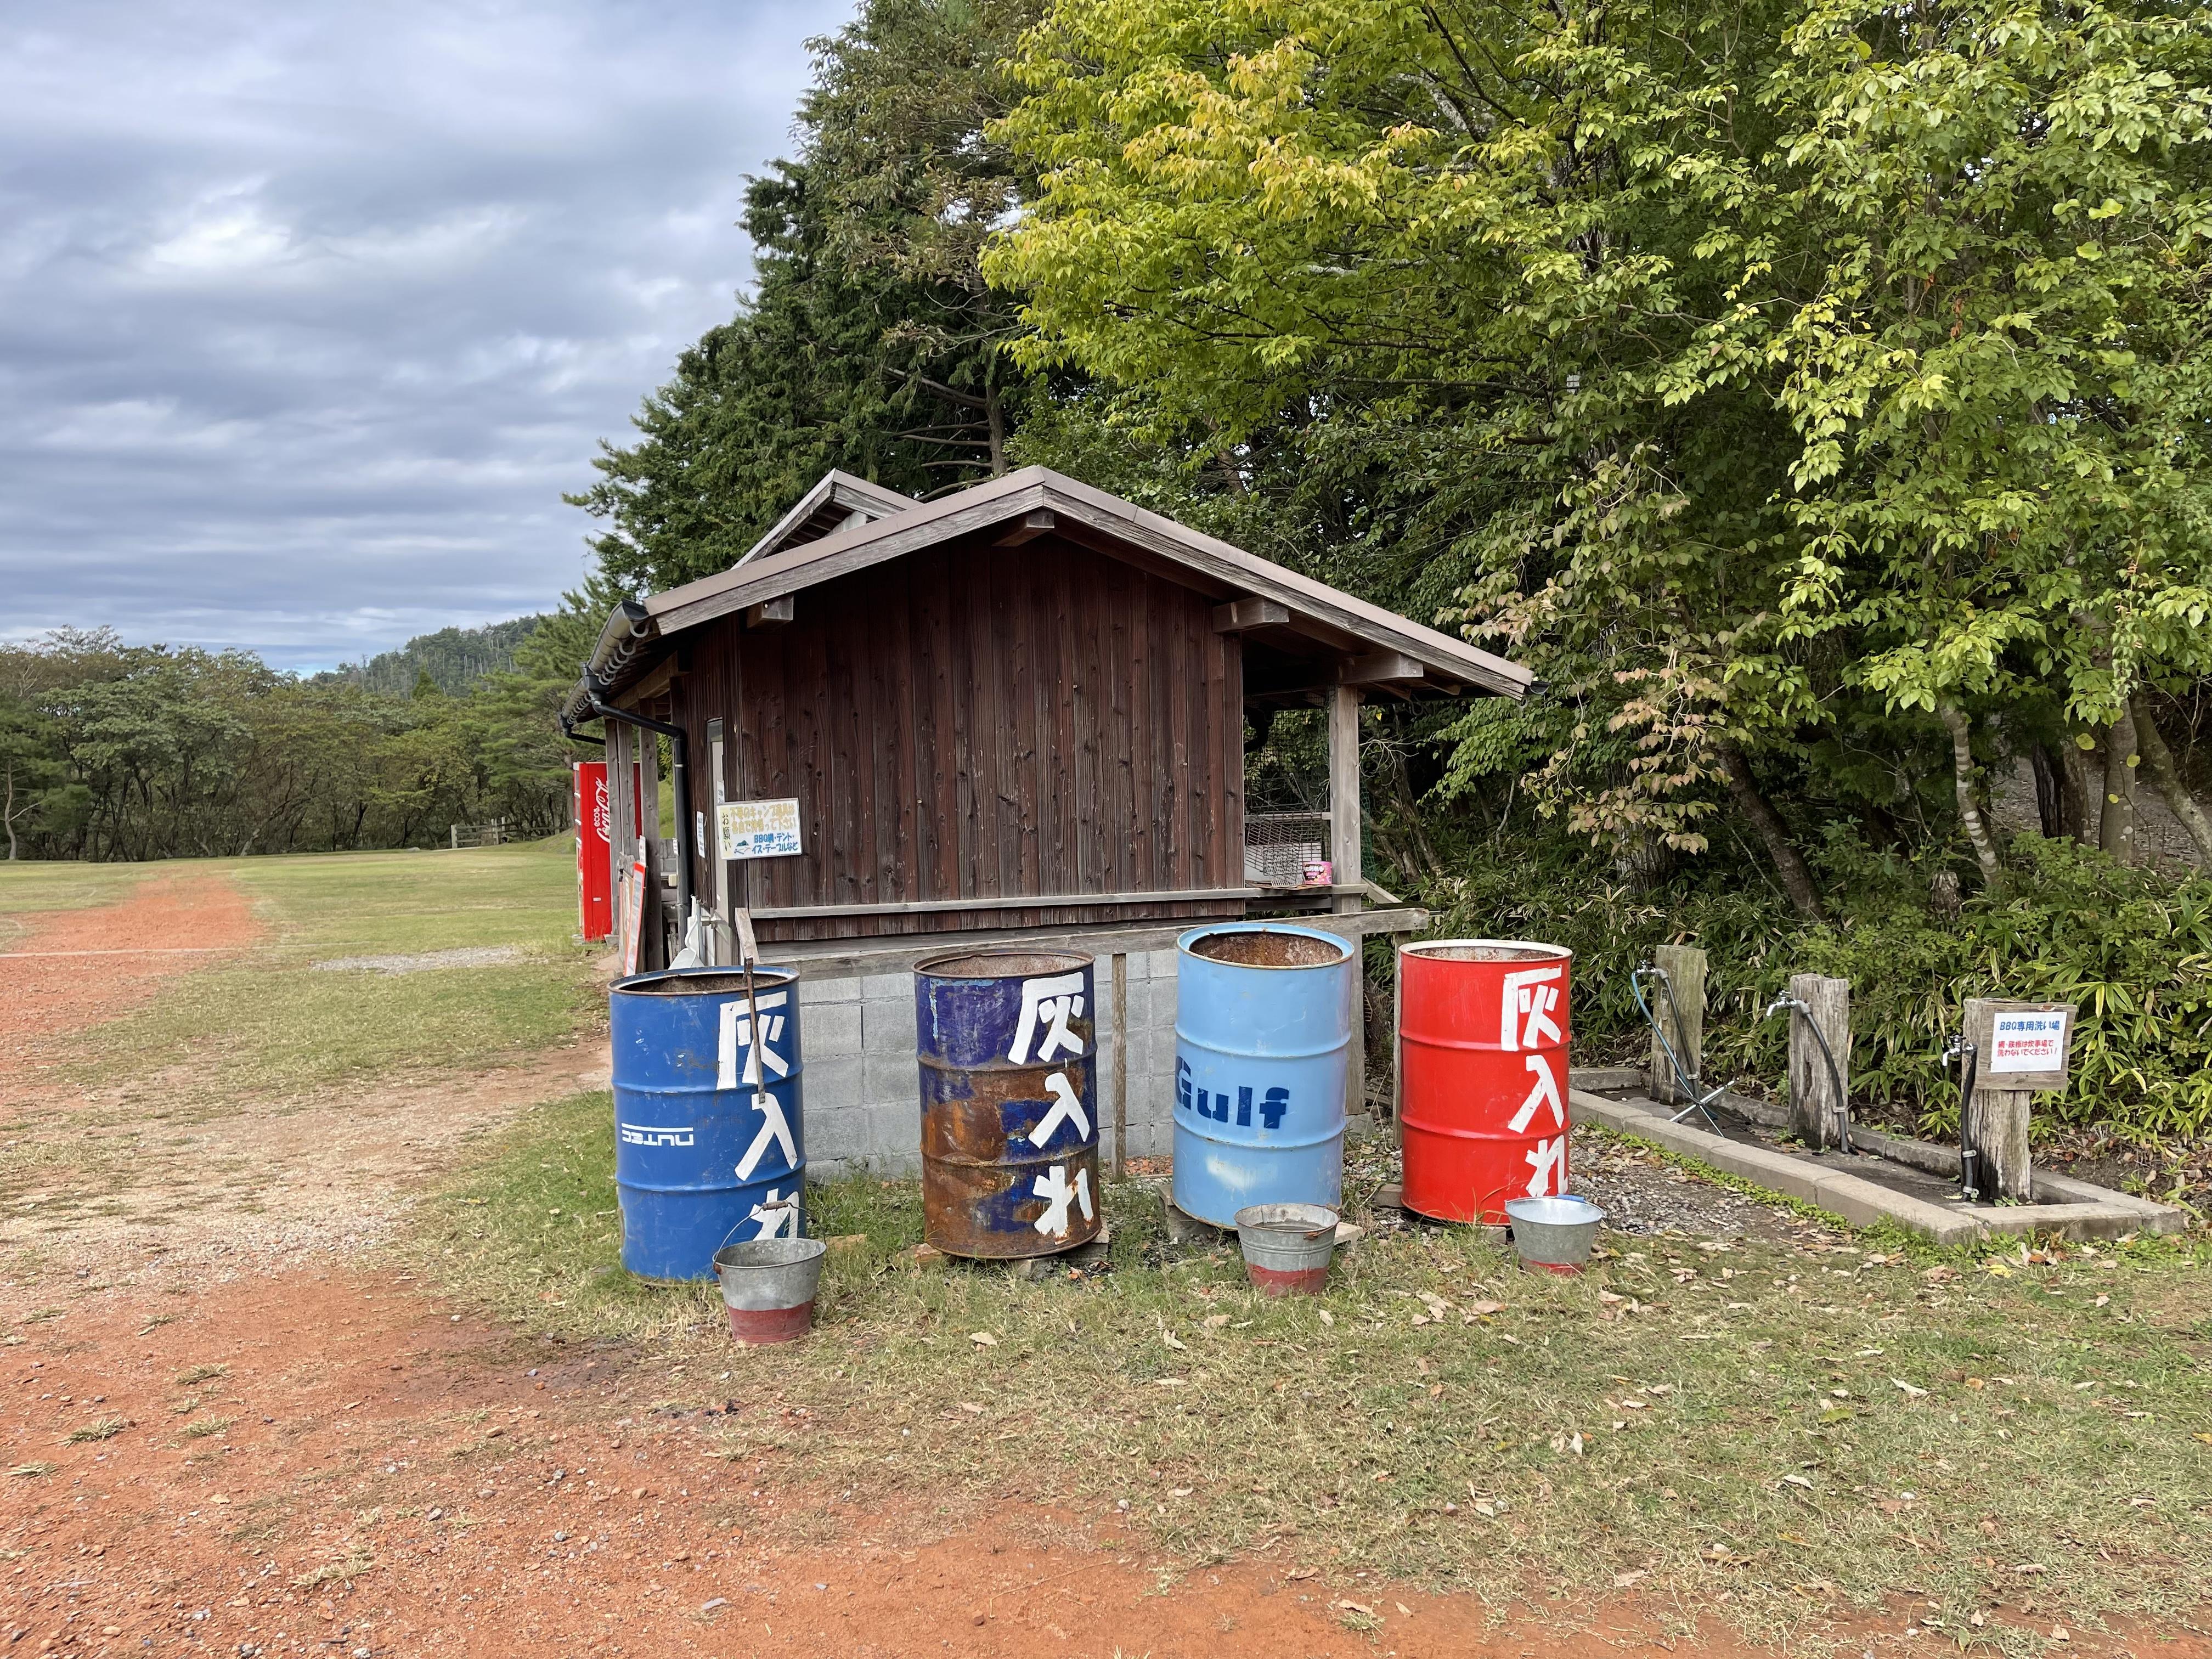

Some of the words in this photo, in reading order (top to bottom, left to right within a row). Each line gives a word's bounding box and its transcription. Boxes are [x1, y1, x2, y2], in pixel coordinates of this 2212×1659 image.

[722, 813, 731, 851] お願い
[2000, 1020, 2060, 1031] BBQ専用洗い場
[1008, 972, 1094, 1245] 灰入れ
[1175, 1056, 1289, 1129] Gulf
[1501, 964, 1568, 1198] 灰入れ
